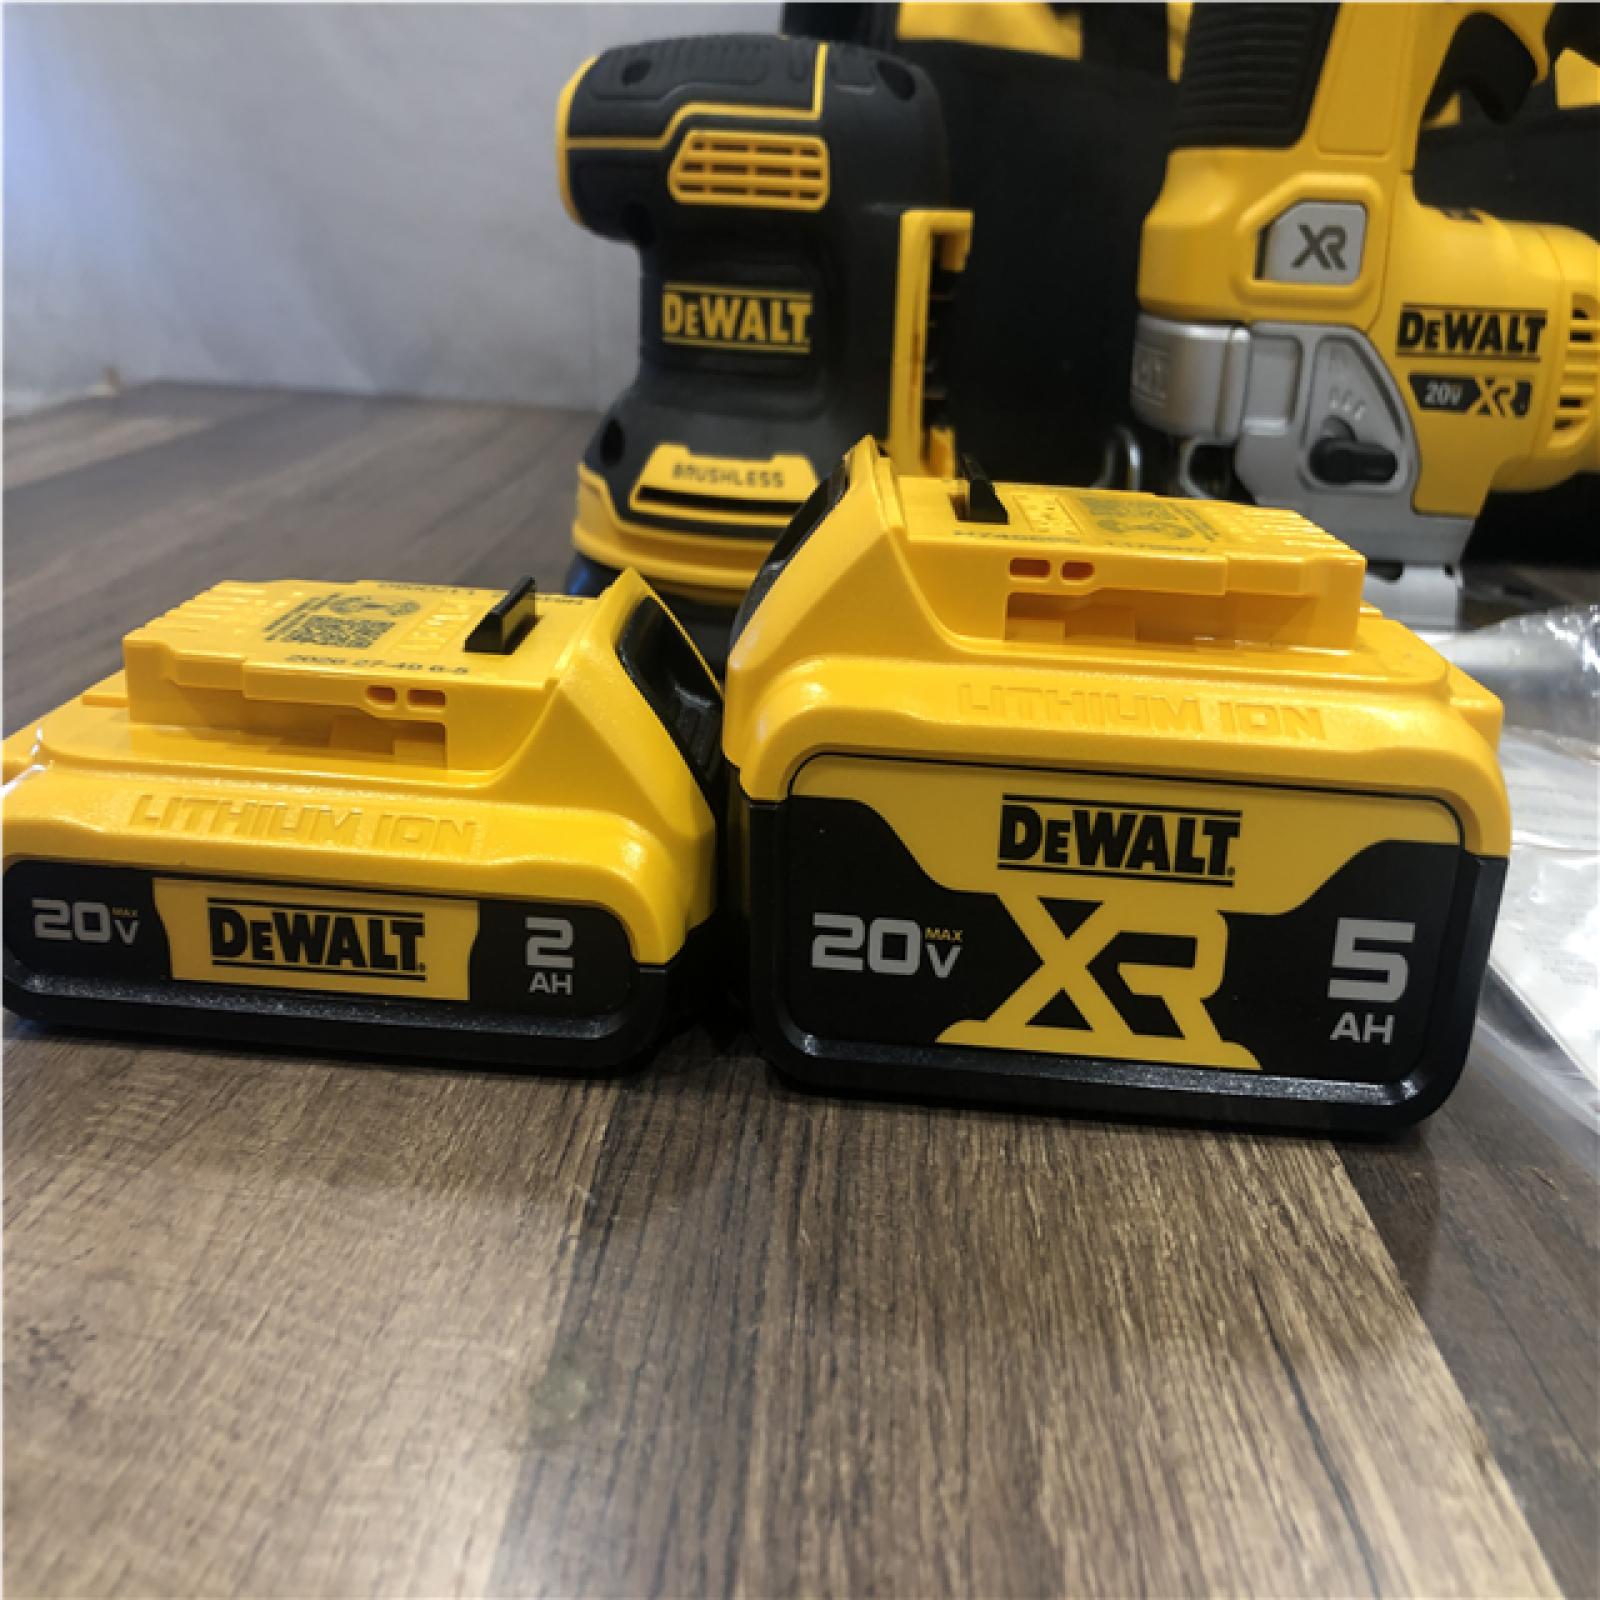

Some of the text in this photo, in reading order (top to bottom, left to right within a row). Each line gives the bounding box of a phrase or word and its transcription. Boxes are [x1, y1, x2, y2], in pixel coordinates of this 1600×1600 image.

[1291, 224, 1347, 271] XR
[662, 293, 812, 345] DEWALT
[1398, 310, 1546, 354] DEWALT
[1425, 380, 1463, 406] 20V
[673, 463, 784, 488] BRUSHLESS
[956, 682, 1327, 741] LITHIUM ION
[128, 793, 479, 854] LITHIUM ION
[998, 804, 1242, 878] DEWALT
[112, 905, 138, 917] MAX
[925, 926, 963, 942] MAX
[208, 905, 425, 973] DEWALT
[524, 916, 575, 970] 2
[1327, 918, 1416, 1002] 5
[529, 970, 573, 996] AH
[936, 893, 1262, 1070] XR
[1330, 1012, 1396, 1045] AH
